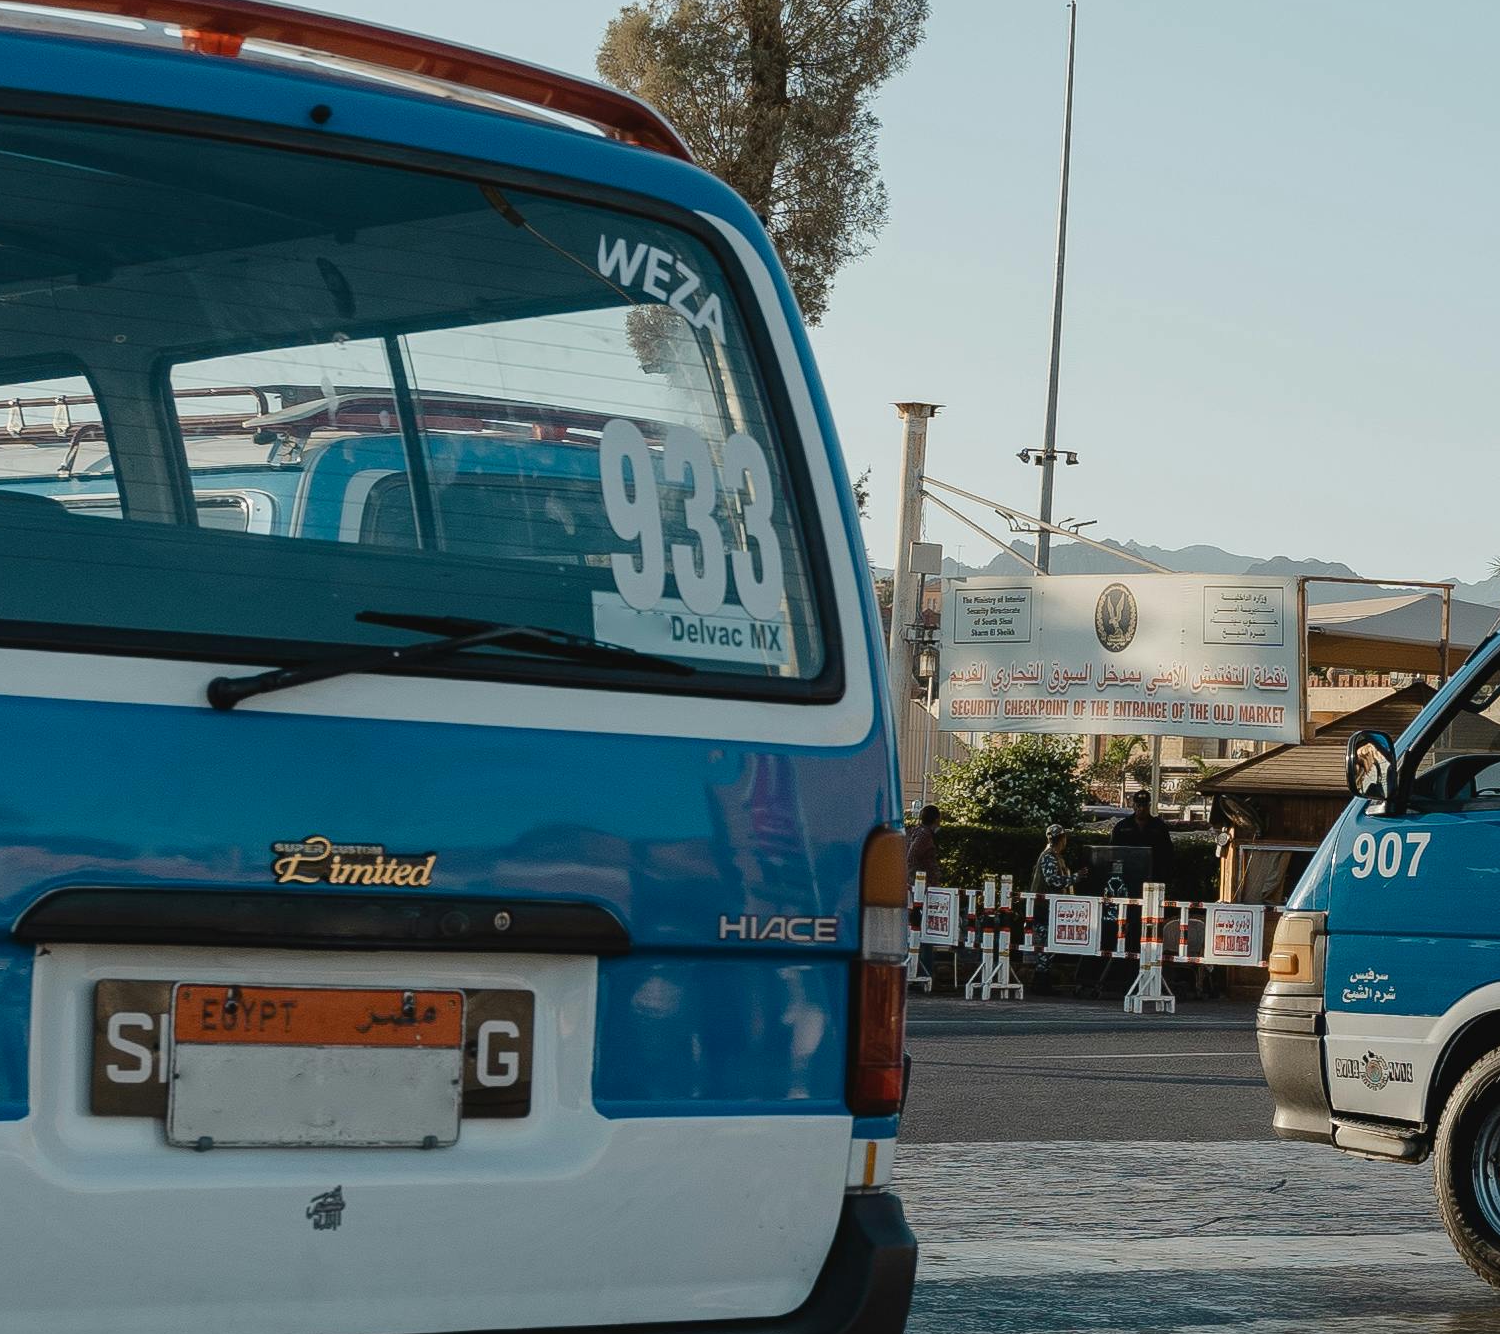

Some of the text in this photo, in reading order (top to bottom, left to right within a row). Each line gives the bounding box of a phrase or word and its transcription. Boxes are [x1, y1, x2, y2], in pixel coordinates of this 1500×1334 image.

[597, 233, 727, 345] WEZA
[600, 418, 785, 621] 933
[671, 614, 783, 652] Delvac MX
[949, 661, 988, 688] القديم
[990, 661, 1045, 693] التجاري
[1047, 662, 1093, 692] السوق
[1097, 663, 1142, 691] بمدخل
[1191, 664, 1249, 691] التفتيش
[1254, 664, 1288, 688] نقطة
[951, 699, 1285, 725] SECURITY CHECKPOINT OF THE ENTRANCE OF THE OLD MARKET
[273, 842, 324, 854] SUPER
[273, 835, 437, 887] Limited
[1351, 831, 1432, 880] 907
[719, 915, 838, 943] HIACE
[1349, 967, 1390, 984] سرفيس
[1373, 985, 1397, 1004] شرم
[202, 998, 299, 1032] EGYPT
[355, 1003, 439, 1034] مصر
